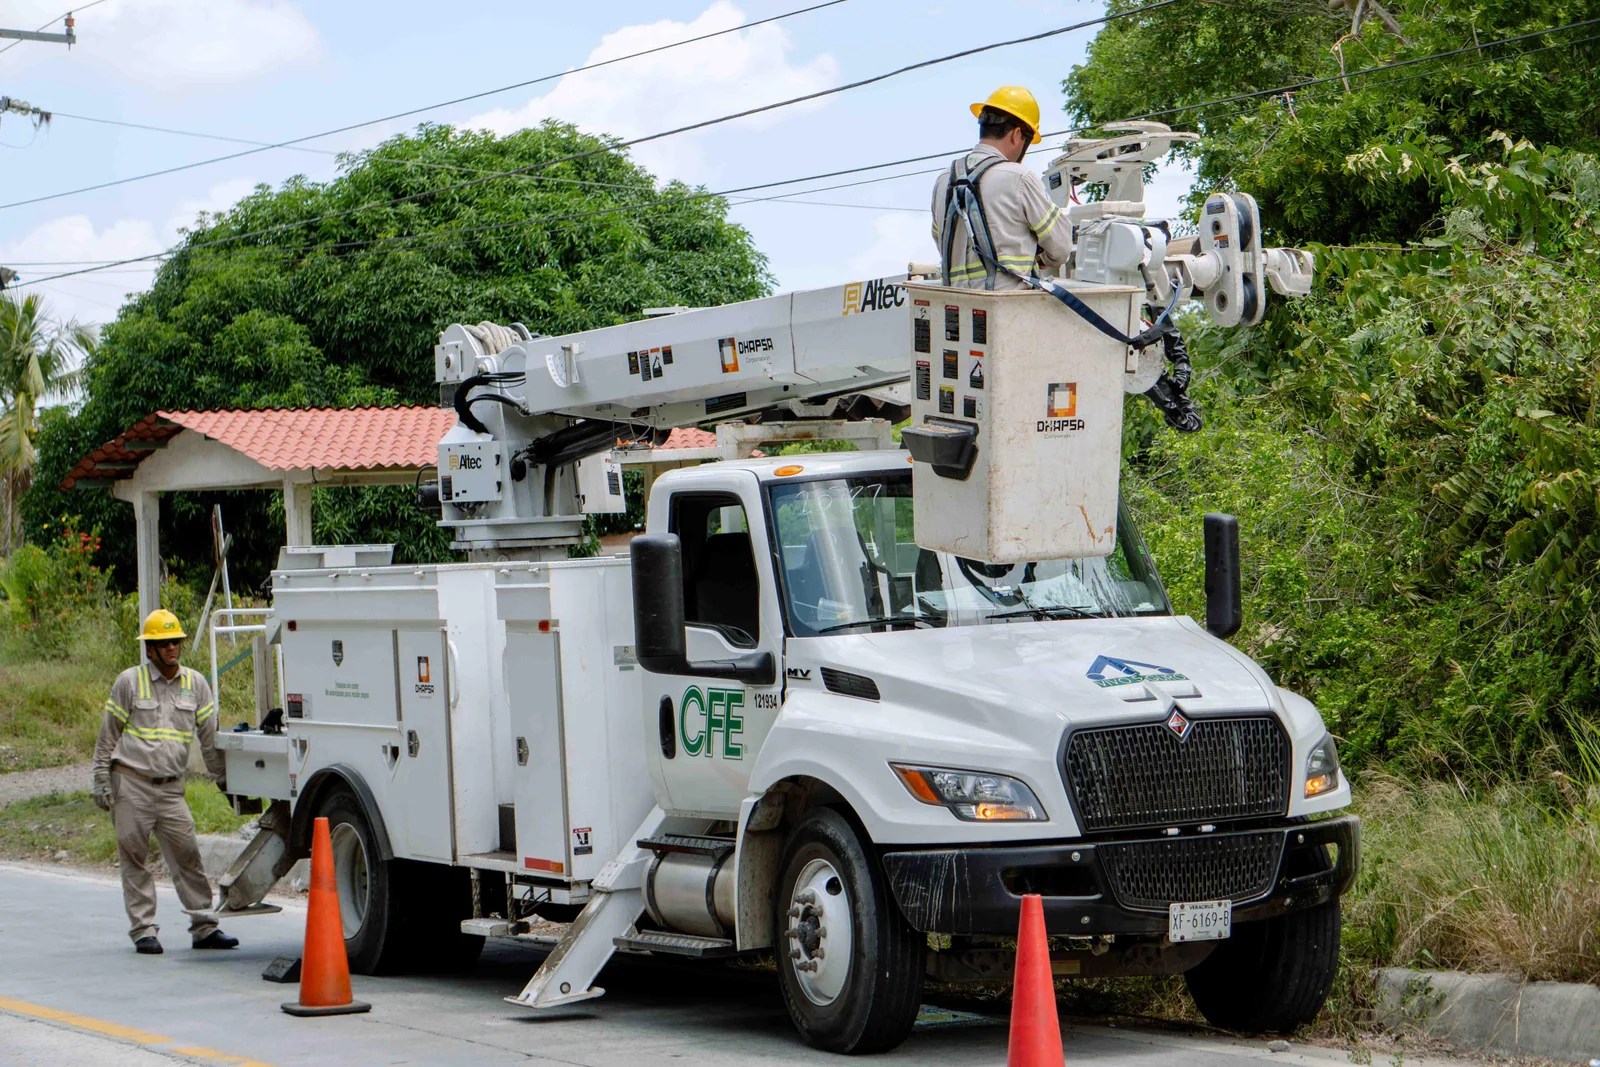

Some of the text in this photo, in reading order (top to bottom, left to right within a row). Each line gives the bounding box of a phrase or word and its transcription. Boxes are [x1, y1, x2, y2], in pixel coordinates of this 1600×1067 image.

[861, 278, 906, 313] Altec
[738, 337, 775, 355] DHAPSA
[1036, 419, 1085, 432] DHAPSA
[459, 454, 482, 469] Altec
[787, 667, 811, 678] MV
[754, 693, 778, 709] 121934
[679, 684, 745, 760] CFE
[1173, 911, 1229, 930] XF-6169-B
